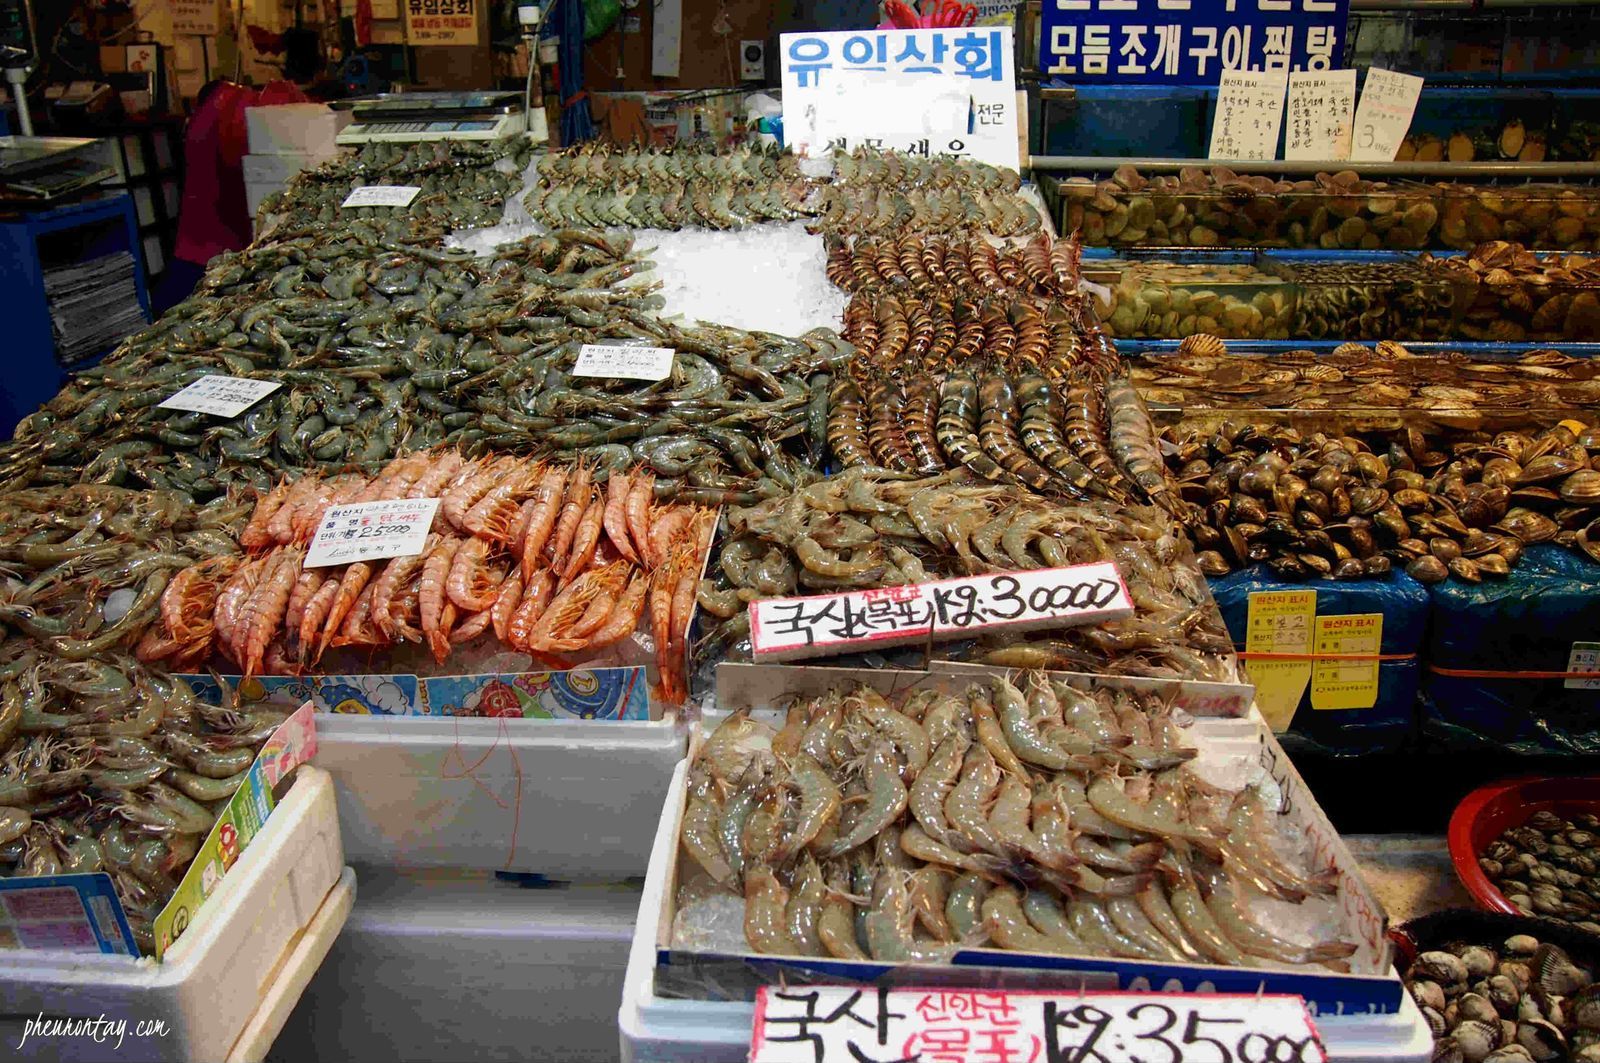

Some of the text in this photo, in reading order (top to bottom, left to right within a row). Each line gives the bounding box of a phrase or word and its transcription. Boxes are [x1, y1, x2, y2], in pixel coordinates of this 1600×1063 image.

[1223, 79, 1243, 87] 원산지
[1292, 81, 1311, 89] 원산지
[1313, 80, 1326, 88] 표시
[977, 103, 1005, 125] 전문
[331, 508, 364, 518] 원산지
[1256, 595, 1308, 605] 원산지 표시
[1323, 619, 1375, 629] 원산지 표시
[915, 992, 1022, 1026] 신안군
